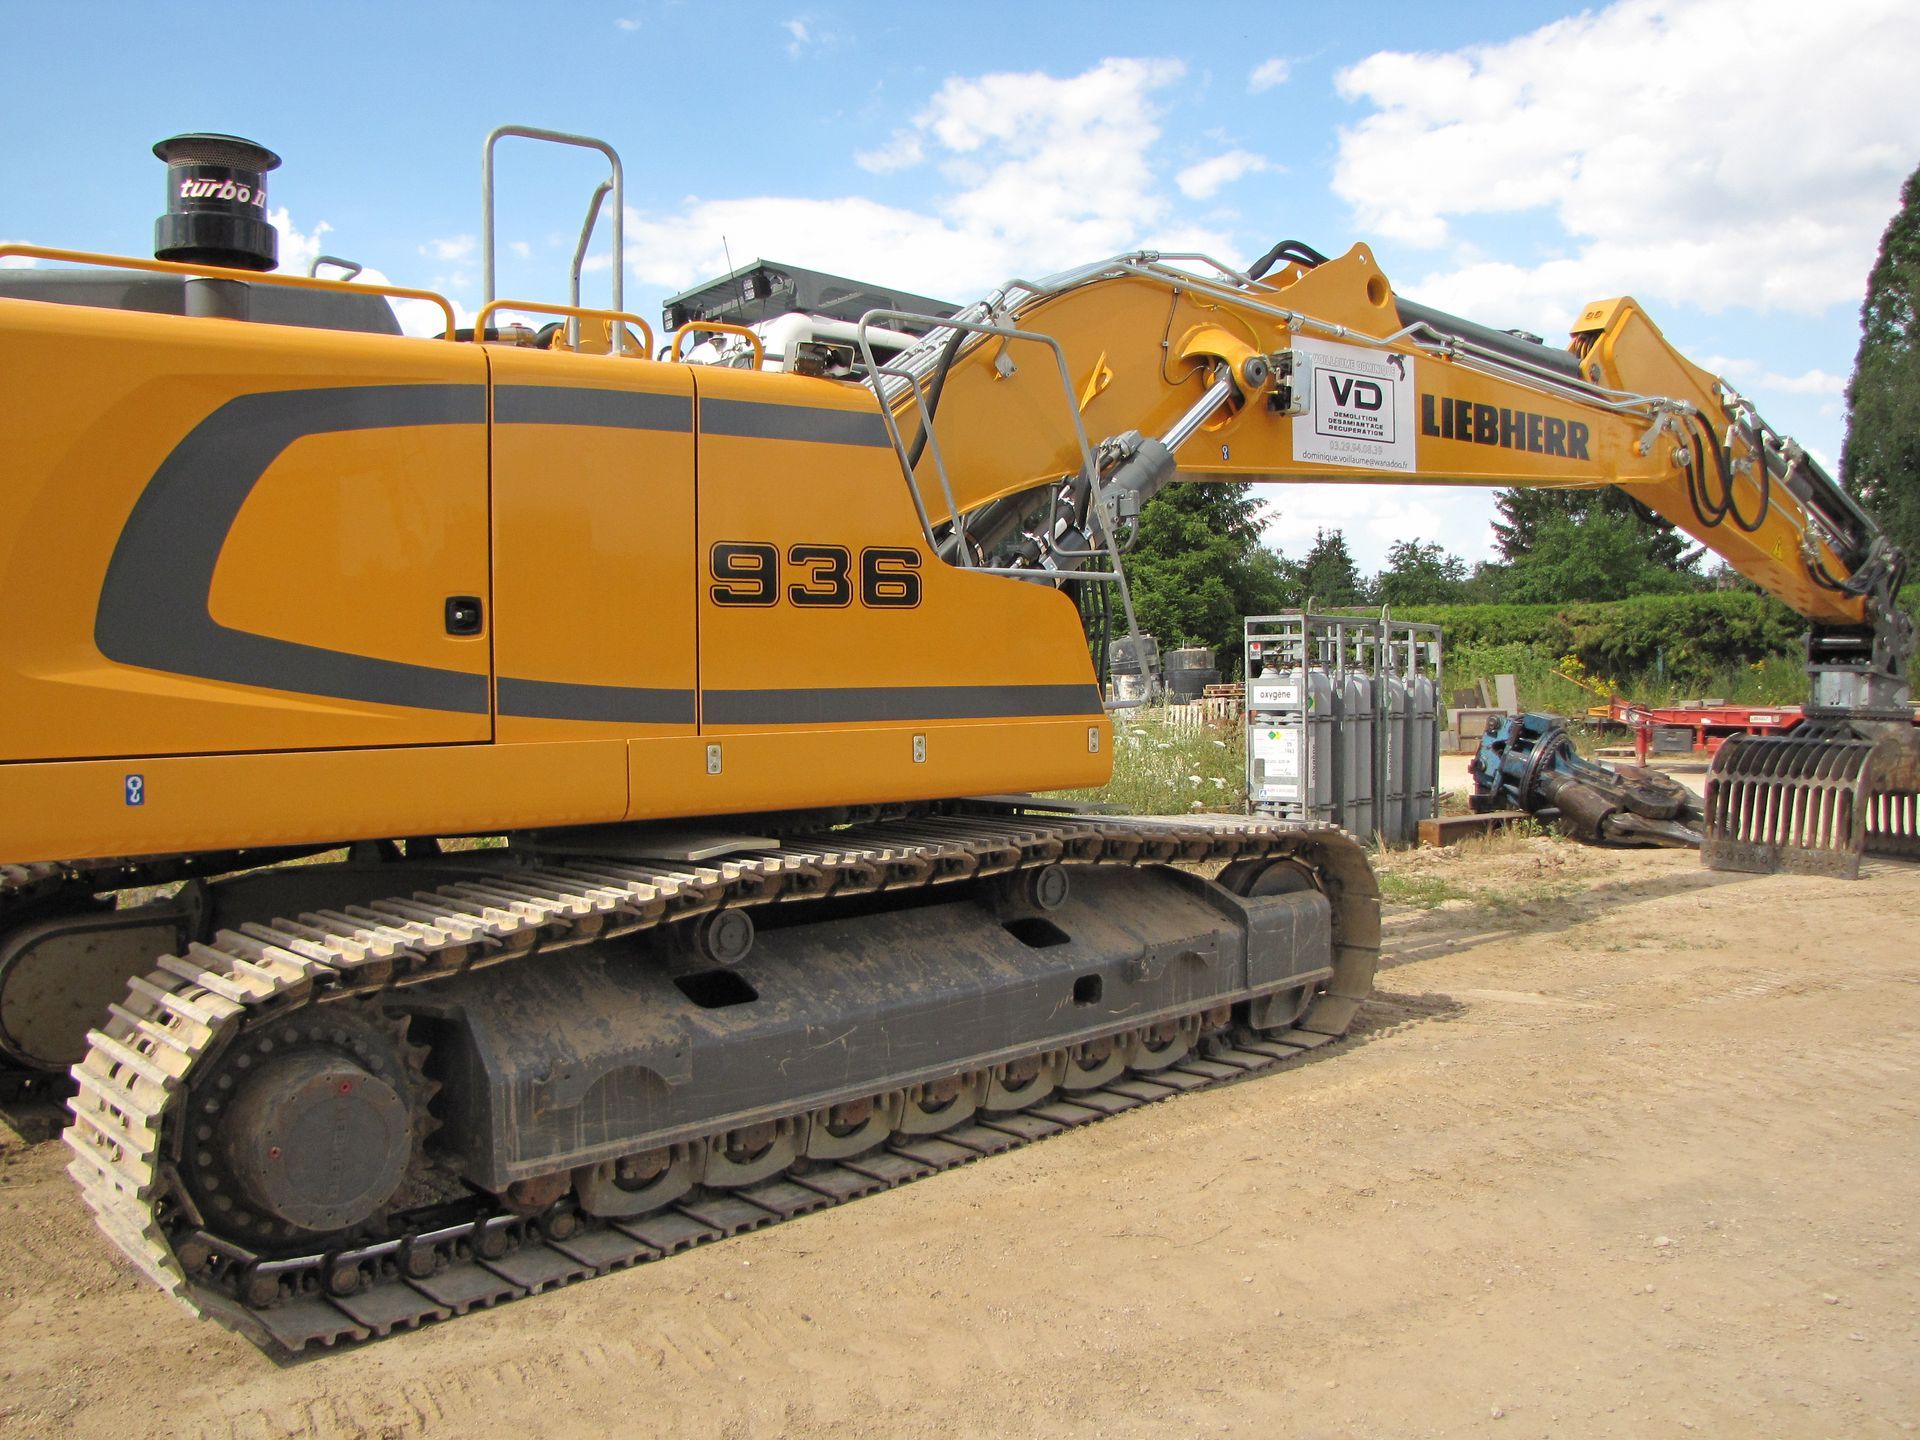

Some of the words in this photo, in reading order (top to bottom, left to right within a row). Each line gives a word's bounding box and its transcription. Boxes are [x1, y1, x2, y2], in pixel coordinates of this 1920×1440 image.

[180, 178, 250, 203] turbo
[1328, 376, 1383, 411] VD
[1328, 417, 1384, 430] DESAMIANTAGE
[1333, 411, 1378, 423] DEMOLITION
[1421, 394, 1590, 461] LIEBHERR
[1328, 424, 1384, 437] RECUPERATION
[709, 541, 922, 609] 936
